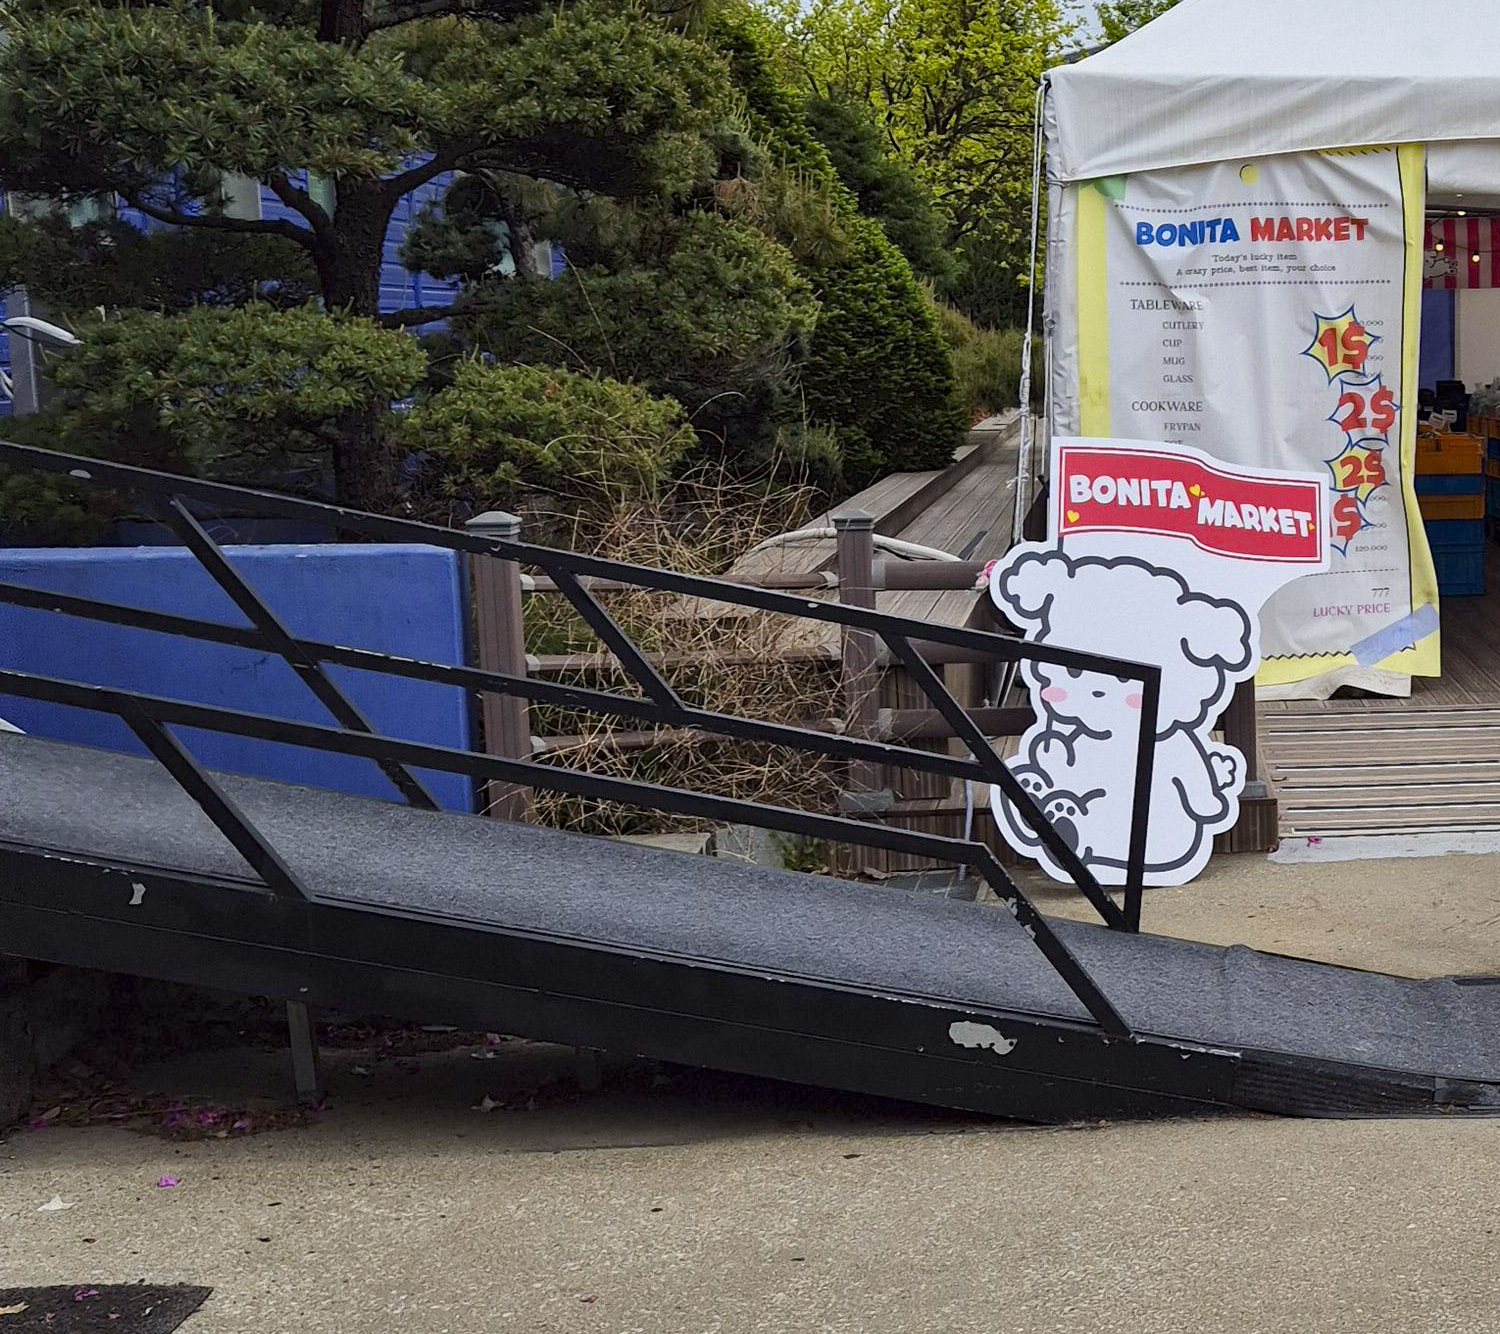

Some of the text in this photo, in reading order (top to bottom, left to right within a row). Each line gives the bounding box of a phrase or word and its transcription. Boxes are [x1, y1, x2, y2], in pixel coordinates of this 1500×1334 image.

[1135, 216, 1368, 248] BONITA MARKET
[1212, 254, 1247, 263] Today's
[1250, 253, 1273, 263] lucky
[1211, 267, 1236, 276] price,
[1286, 265, 1306, 273] your
[1309, 264, 1336, 272] choice
[1130, 299, 1204, 311] TABLEWARE
[1162, 321, 1204, 330] CUTLERY
[1162, 339, 1182, 347] CUP
[1318, 321, 1368, 369] 1$
[1162, 357, 1185, 365] MUG
[1163, 375, 1194, 383] GLASS
[1131, 401, 1203, 412] COOKWARE
[1339, 385, 1395, 433] 2$
[1164, 422, 1201, 431] FRYPAN
[1340, 450, 1385, 487] 2$
[1069, 474, 1313, 537] BONITA MARKET
[1372, 587, 1390, 597] 777
[1313, 603, 1391, 617] LUCKY PRICE
